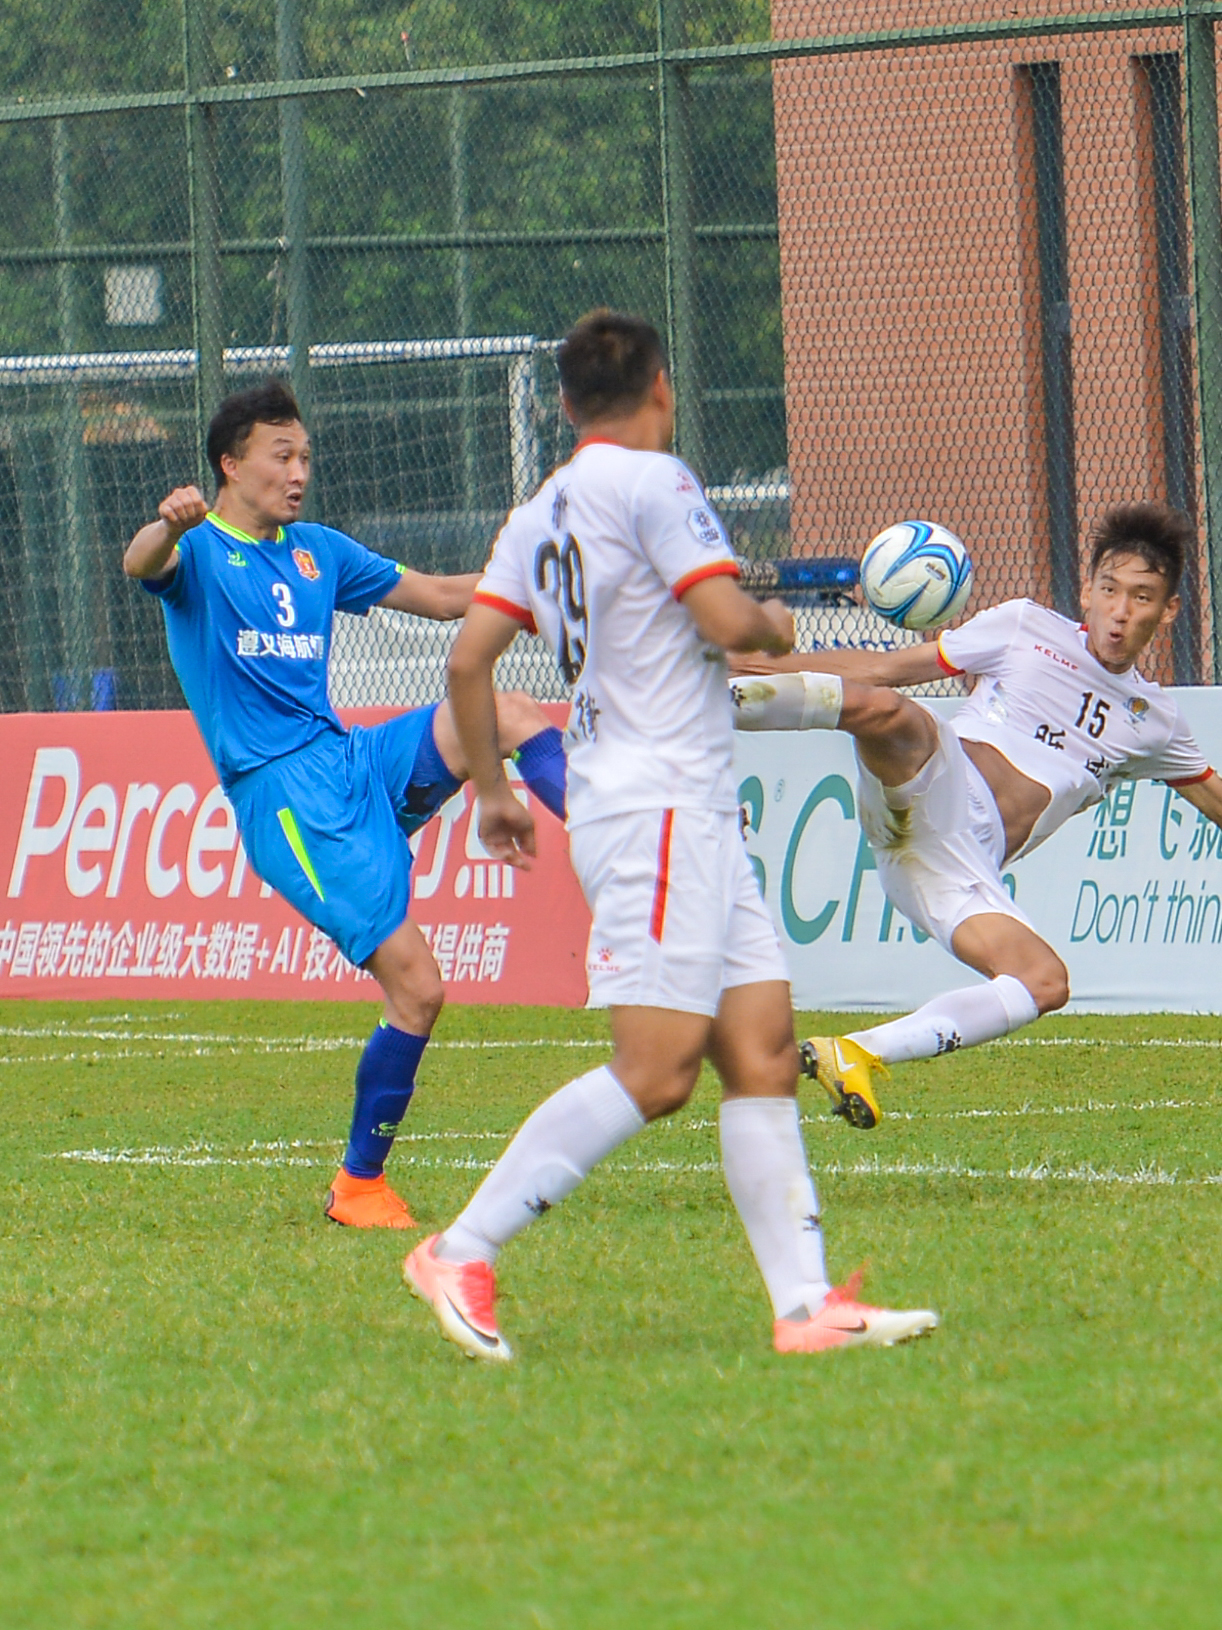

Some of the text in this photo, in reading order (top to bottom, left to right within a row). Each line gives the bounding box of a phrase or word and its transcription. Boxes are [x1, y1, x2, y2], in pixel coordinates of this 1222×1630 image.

[272, 582, 296, 628] 3
[1075, 690, 1111, 739] 15
[8, 746, 275, 899] Perce
[1070, 879, 1159, 944] Don't
